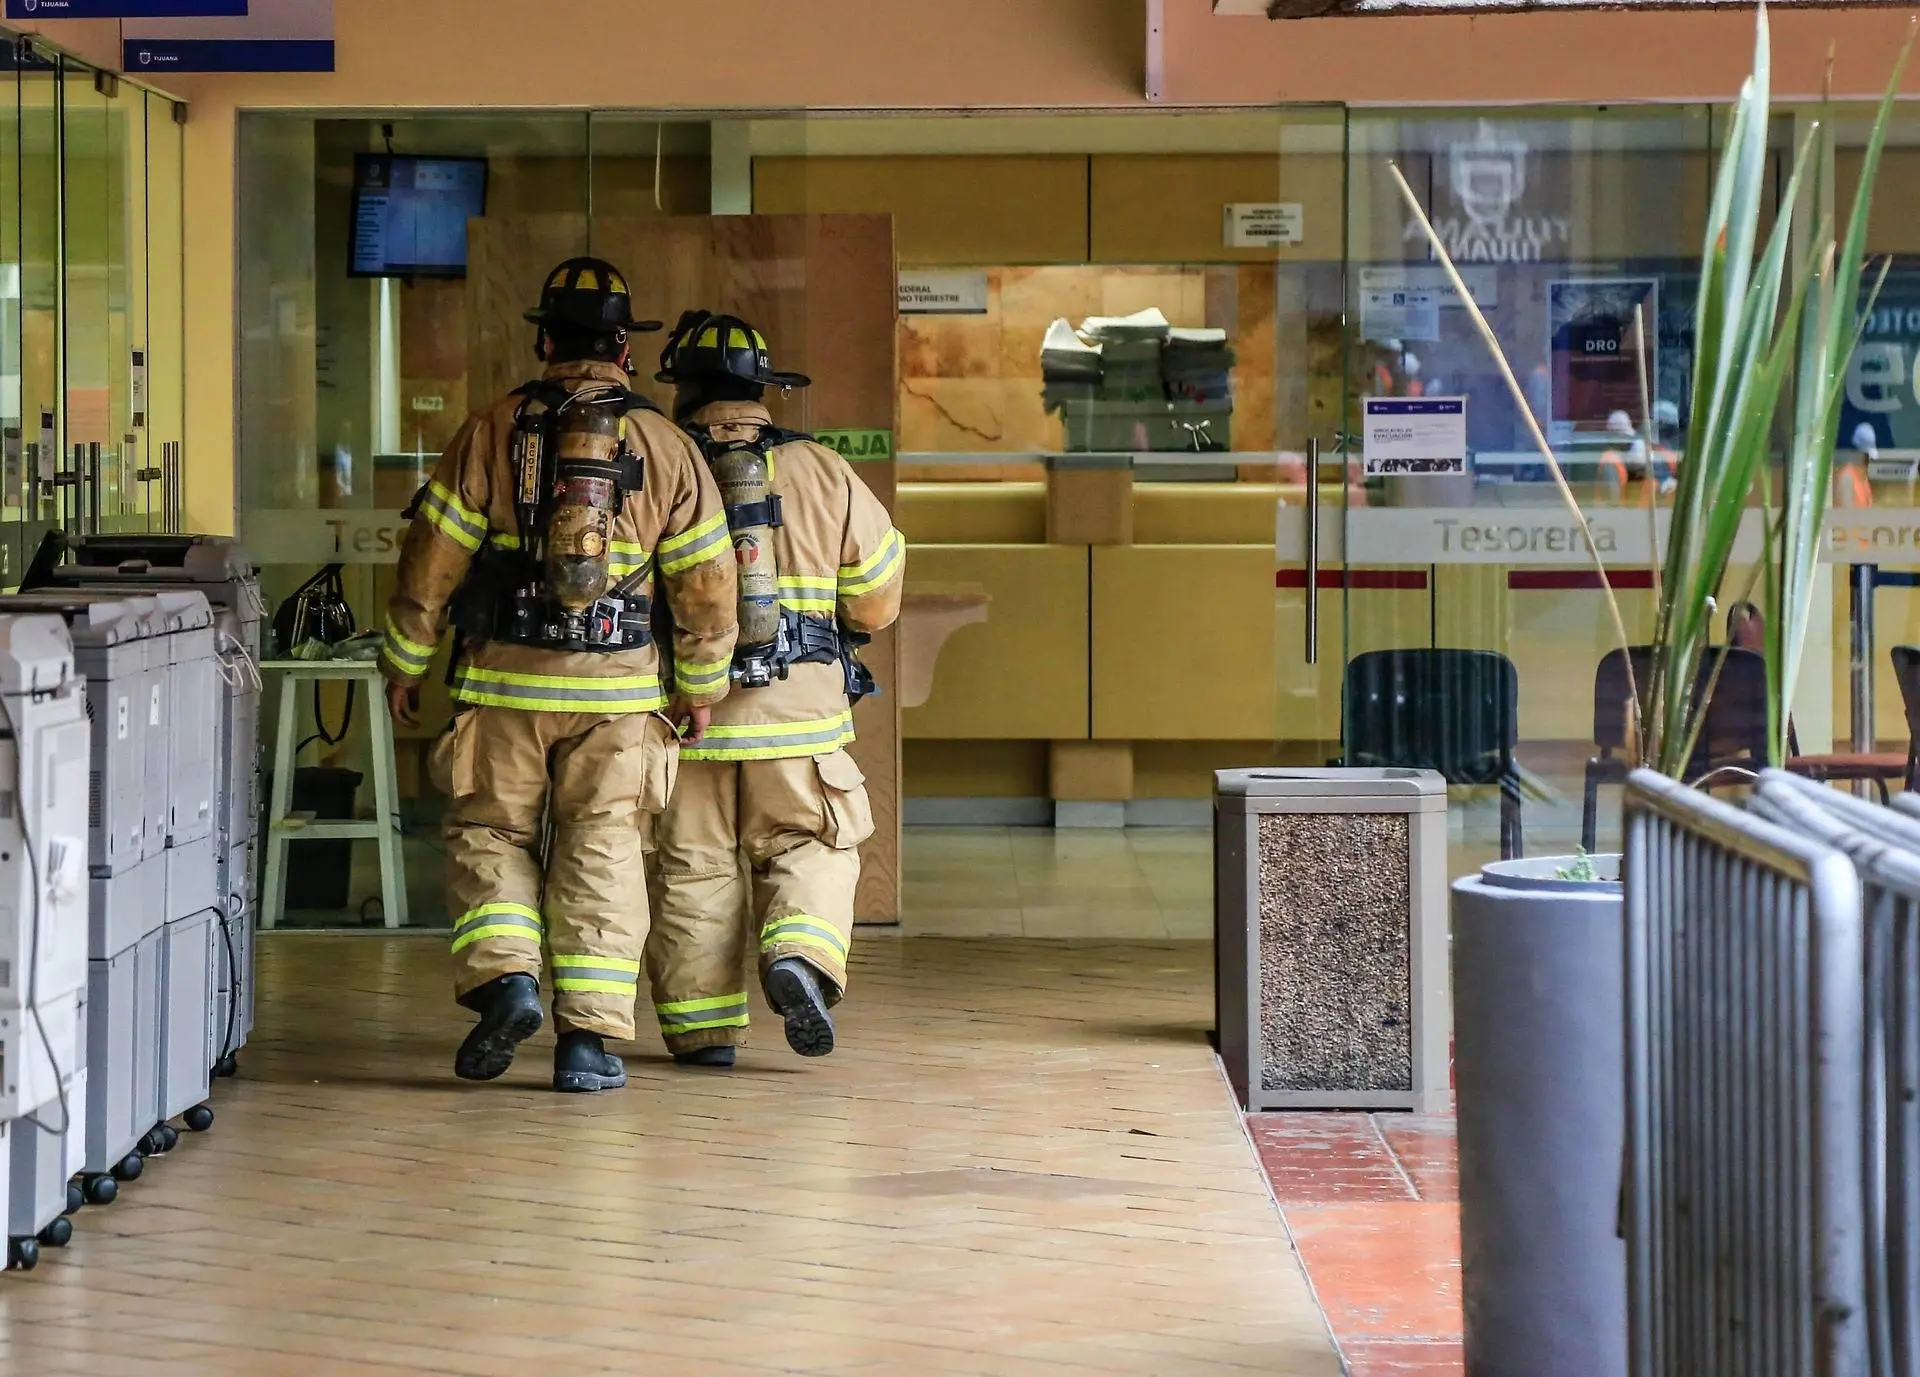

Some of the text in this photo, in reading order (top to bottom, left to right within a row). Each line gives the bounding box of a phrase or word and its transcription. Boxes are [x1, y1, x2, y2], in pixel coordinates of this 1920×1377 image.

[899, 285, 932, 293] EDERAL
[914, 293, 960, 303] TERRESTRE
[1585, 339, 1617, 352] DRO
[817, 434, 888, 456] CAJA
[527, 441, 536, 480] SCOTT
[1433, 517, 1618, 552] Tesorería
[1826, 526, 1920, 552] esor
